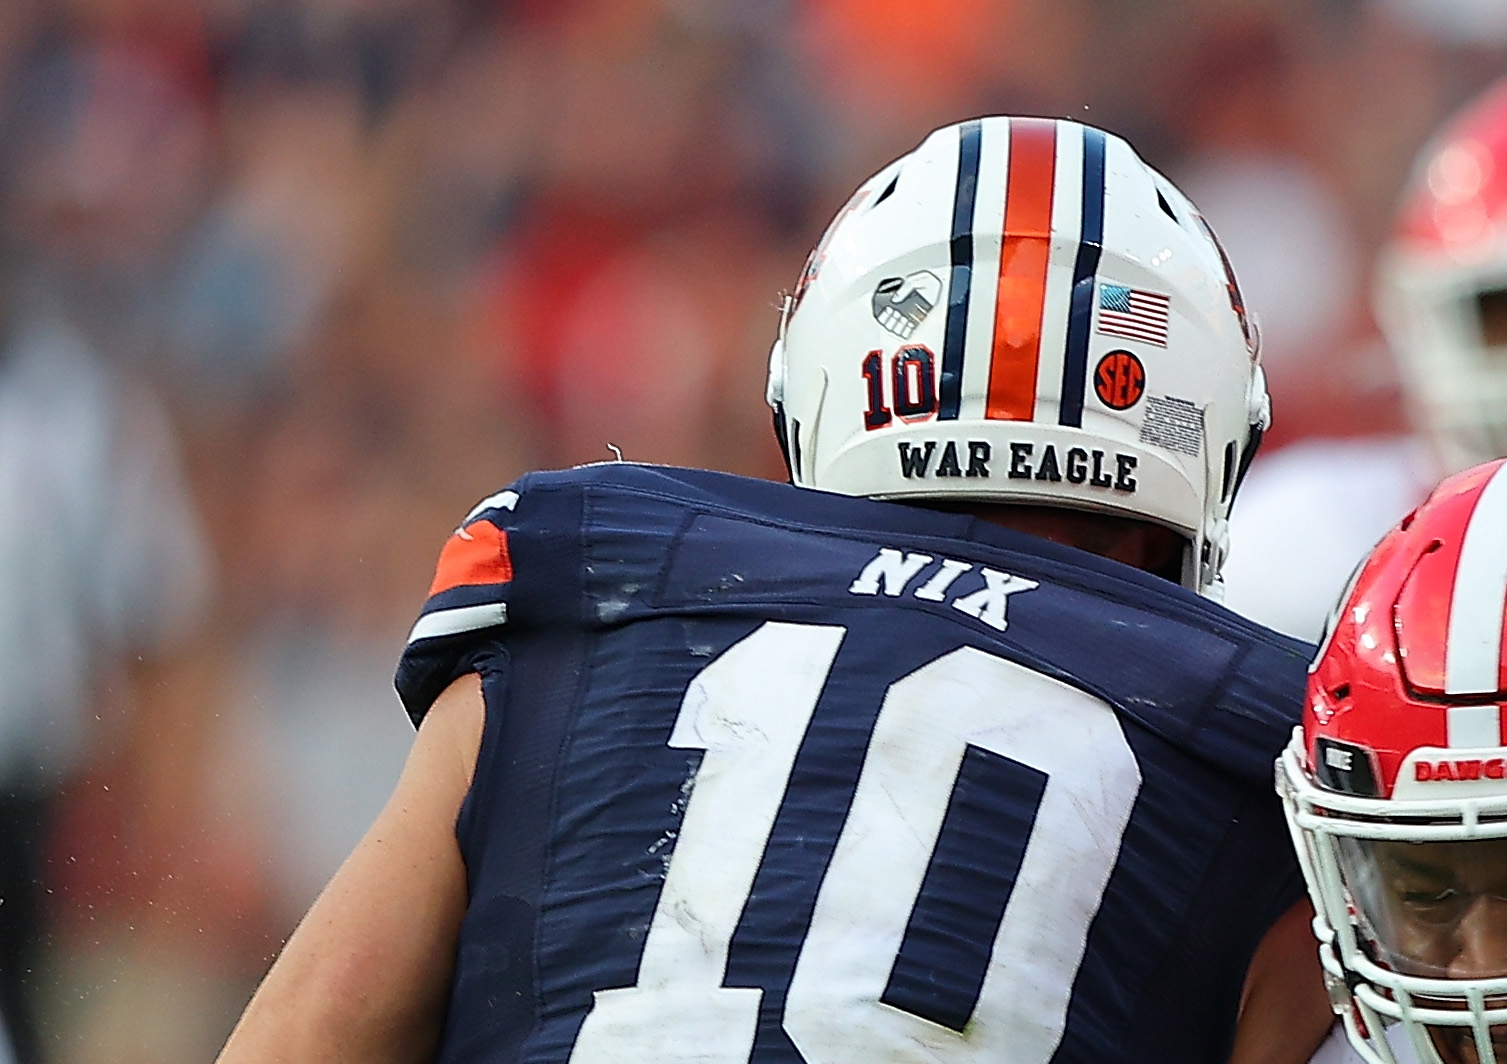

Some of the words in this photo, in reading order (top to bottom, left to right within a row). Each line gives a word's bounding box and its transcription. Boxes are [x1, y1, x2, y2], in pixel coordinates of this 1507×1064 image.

[862, 344, 939, 431] 10
[1098, 353, 1142, 406] SEC
[899, 441, 991, 480] WAR
[1009, 442, 1138, 494] EAGLE
[848, 547, 1041, 633] NIX
